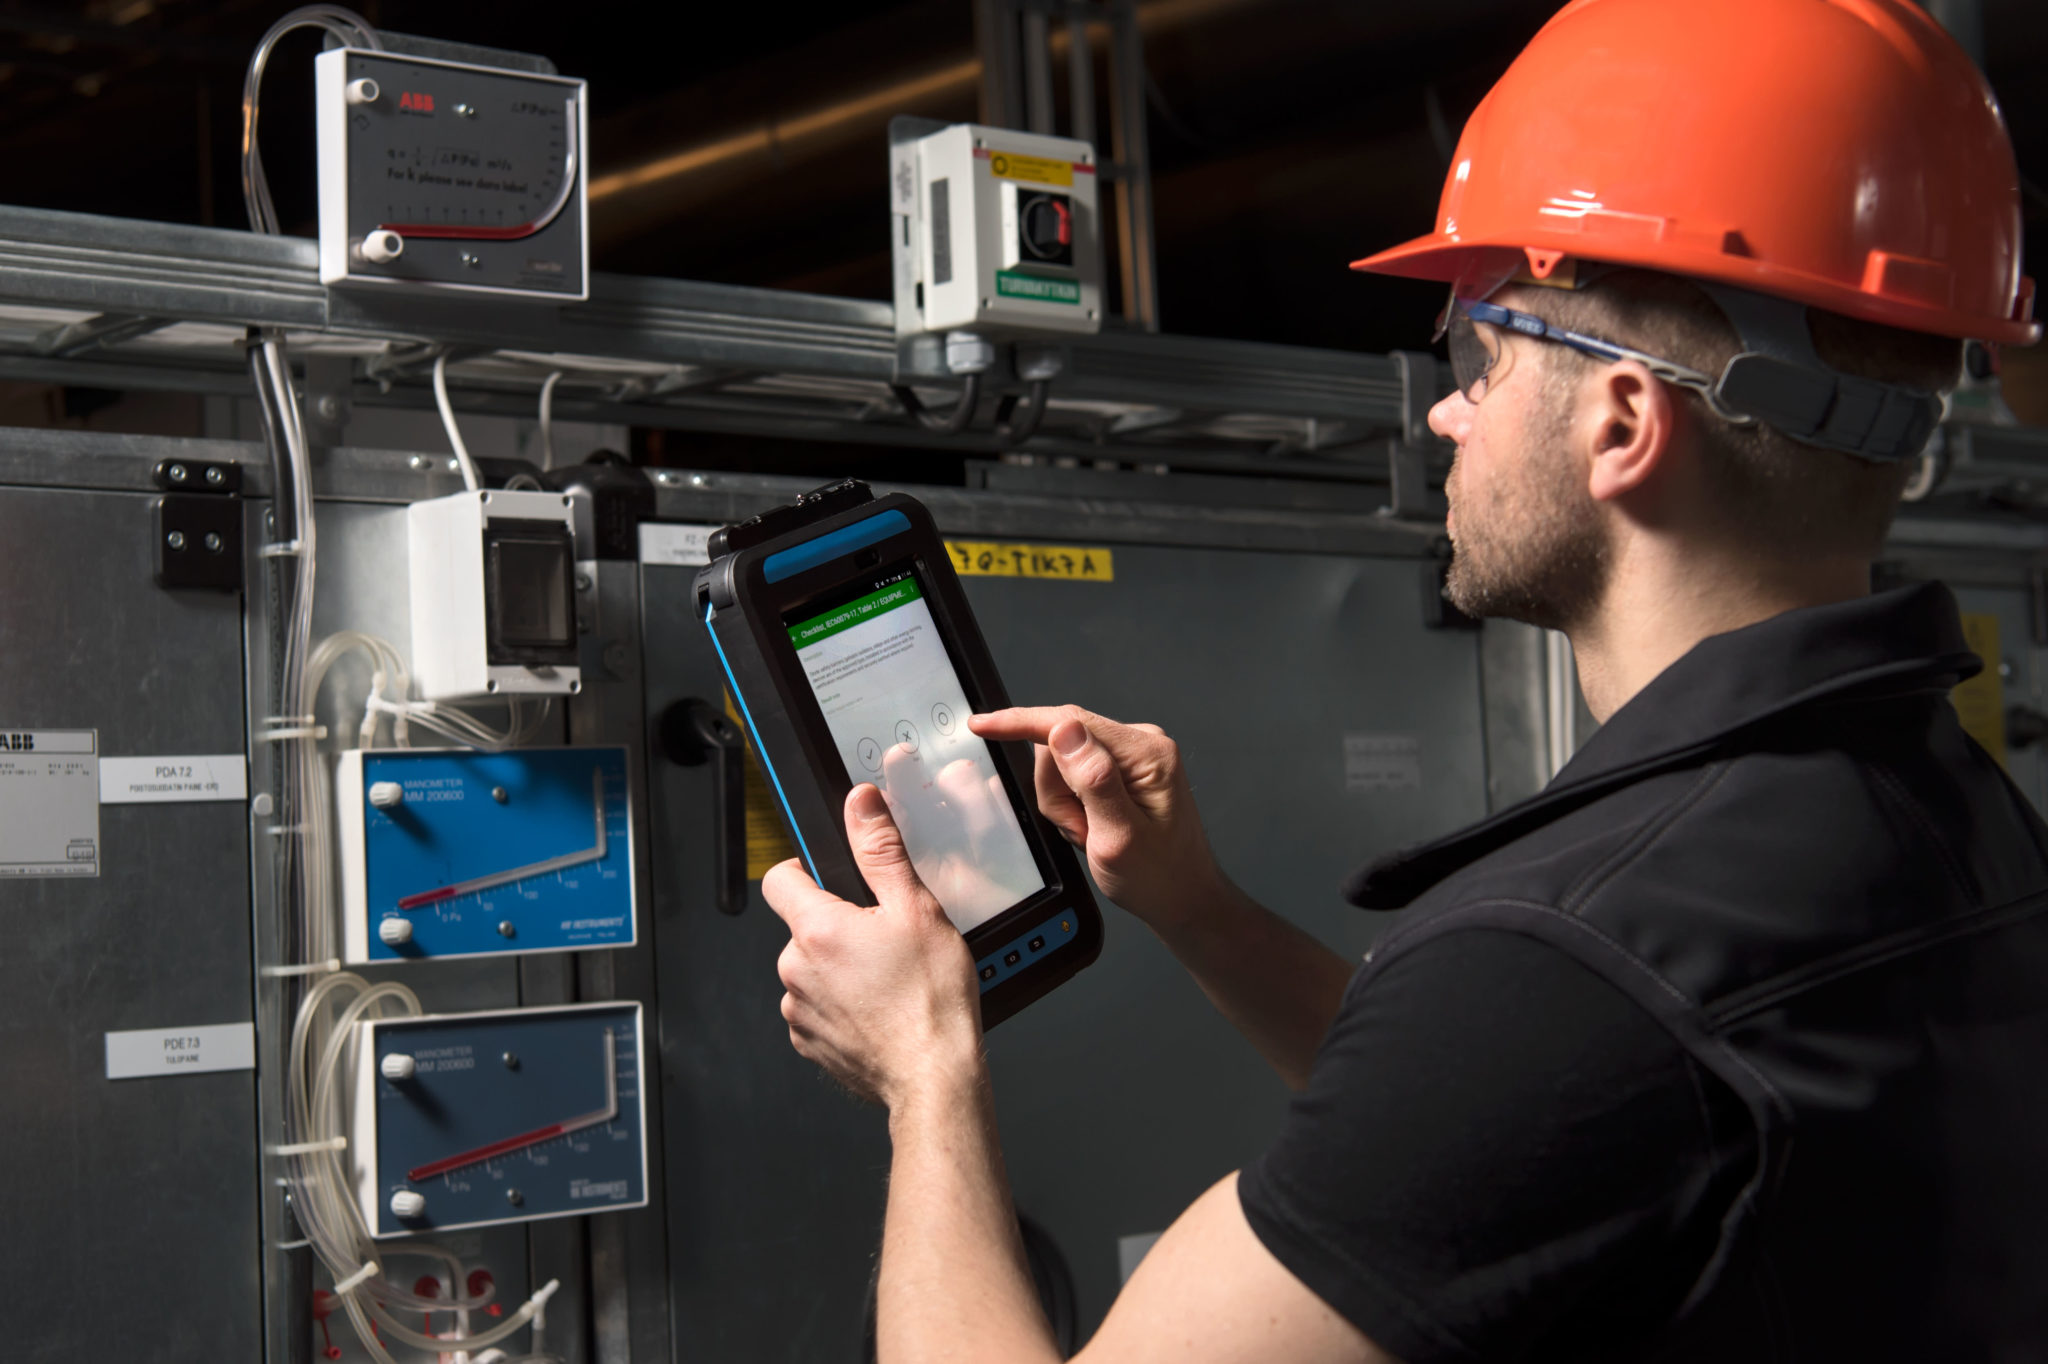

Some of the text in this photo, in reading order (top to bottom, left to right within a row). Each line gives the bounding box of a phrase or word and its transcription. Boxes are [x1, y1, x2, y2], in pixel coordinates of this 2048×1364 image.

[400, 92, 434, 111] ABB
[388, 167, 404, 179] For
[418, 172, 452, 184] please
[477, 178, 500, 191] data
[502, 181, 528, 193] label
[0, 734, 34, 750] ABB
[155, 766, 193, 778] PDA 7.2
[404, 778, 463, 789] MANOMETER
[405, 789, 465, 802] MM 200600
[164, 1036, 201, 1050] PDE 7.3
[415, 1046, 472, 1059] MANOMETER
[415, 1058, 474, 1072] MM 200600
